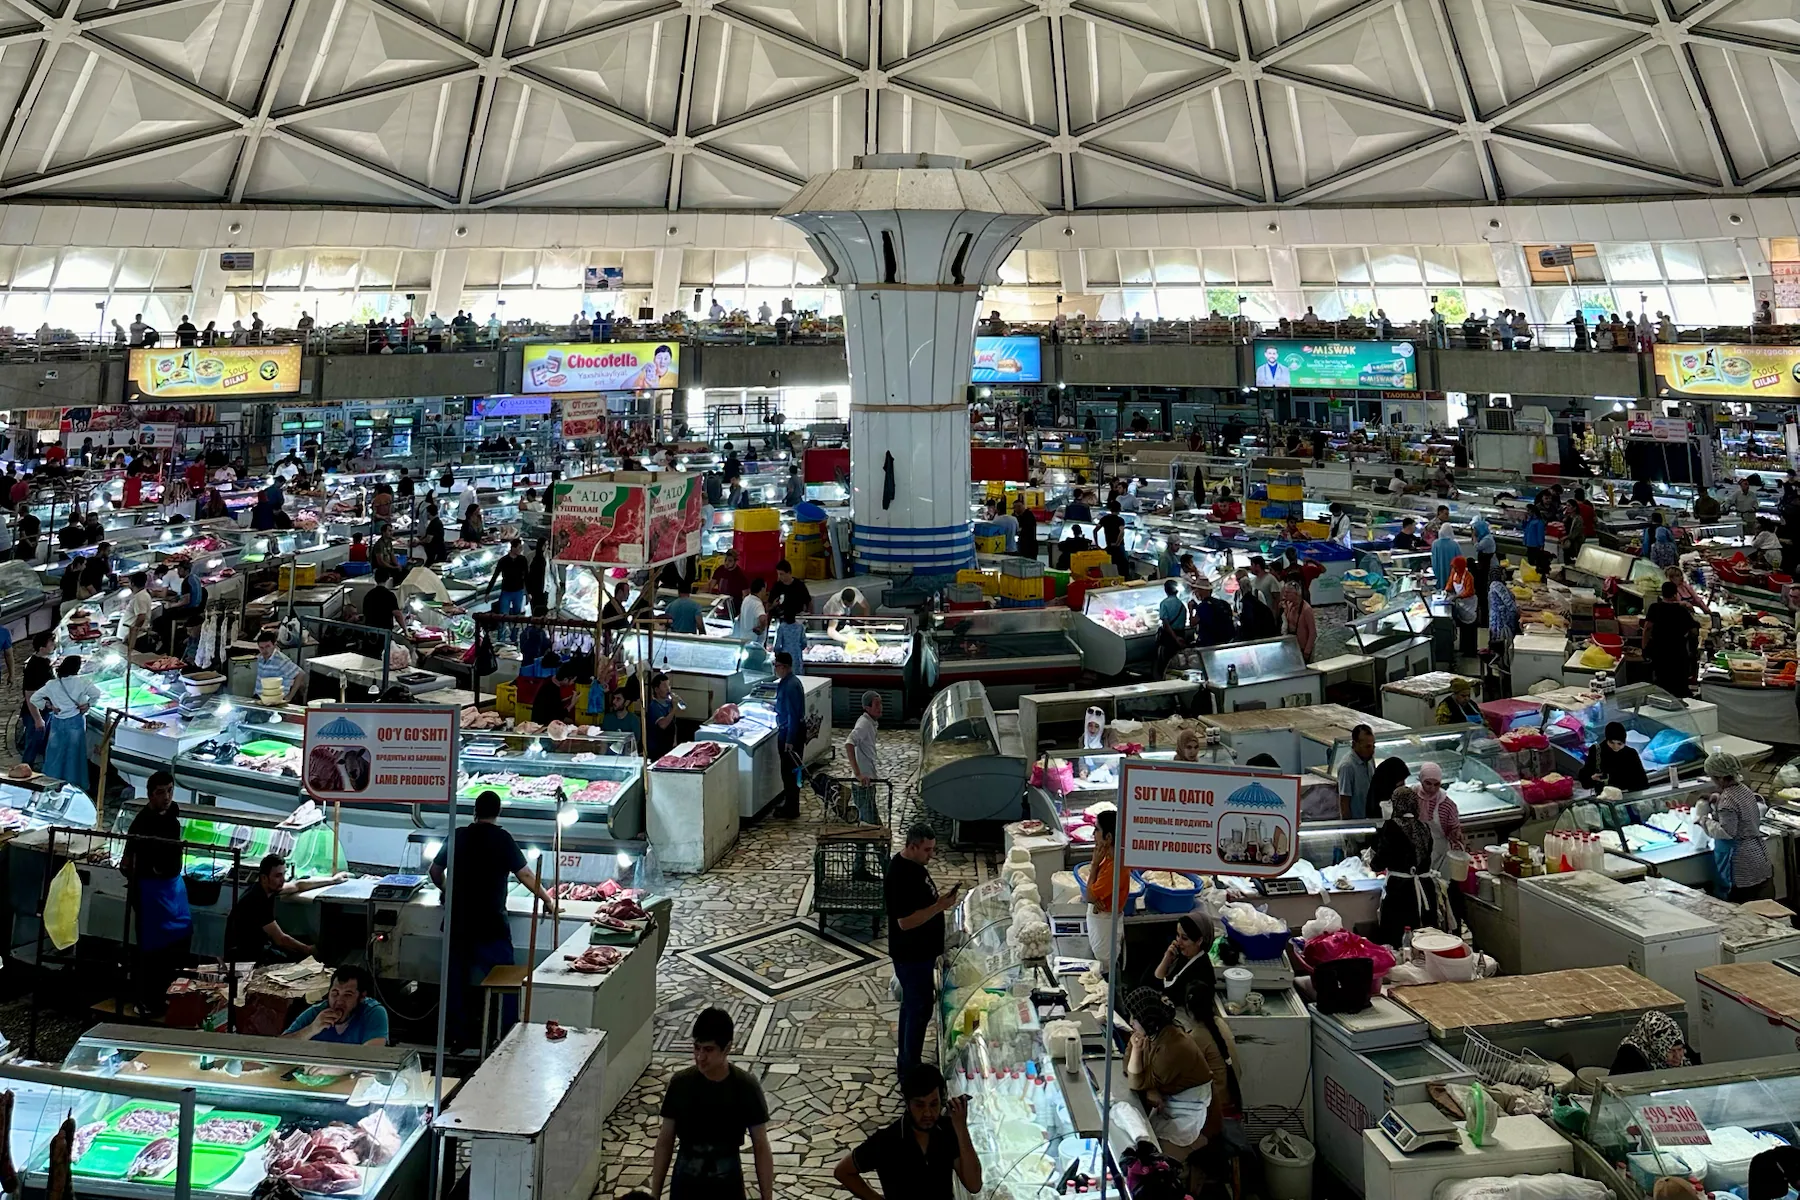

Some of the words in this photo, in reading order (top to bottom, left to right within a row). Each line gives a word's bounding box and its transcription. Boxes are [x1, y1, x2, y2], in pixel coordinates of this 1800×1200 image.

[1313, 346, 1356, 355] MISWAK
[567, 353, 638, 369] Chocotella
[224, 374, 246, 387] BILAN
[1754, 375, 1777, 388] BILAN
[376, 754, 407, 762] ПРОДУКТЫ
[415, 754, 447, 762] БАРАНИНЫ
[375, 774, 398, 785] LAMB
[399, 774, 446, 786] PRODUCTS
[1134, 786, 1158, 801] SUT
[1161, 788, 1176, 803] VA
[1179, 789, 1214, 807] QATIQ
[1133, 815, 1174, 826] МОЛОЧНЫЕ
[1174, 818, 1213, 829] ПРОДУКТЫ
[1132, 838, 1160, 852] DAIRY
[1161, 840, 1212, 855] PRODUCTS
[560, 855, 582, 867] 257
[1643, 1105, 1698, 1124] 499-500
